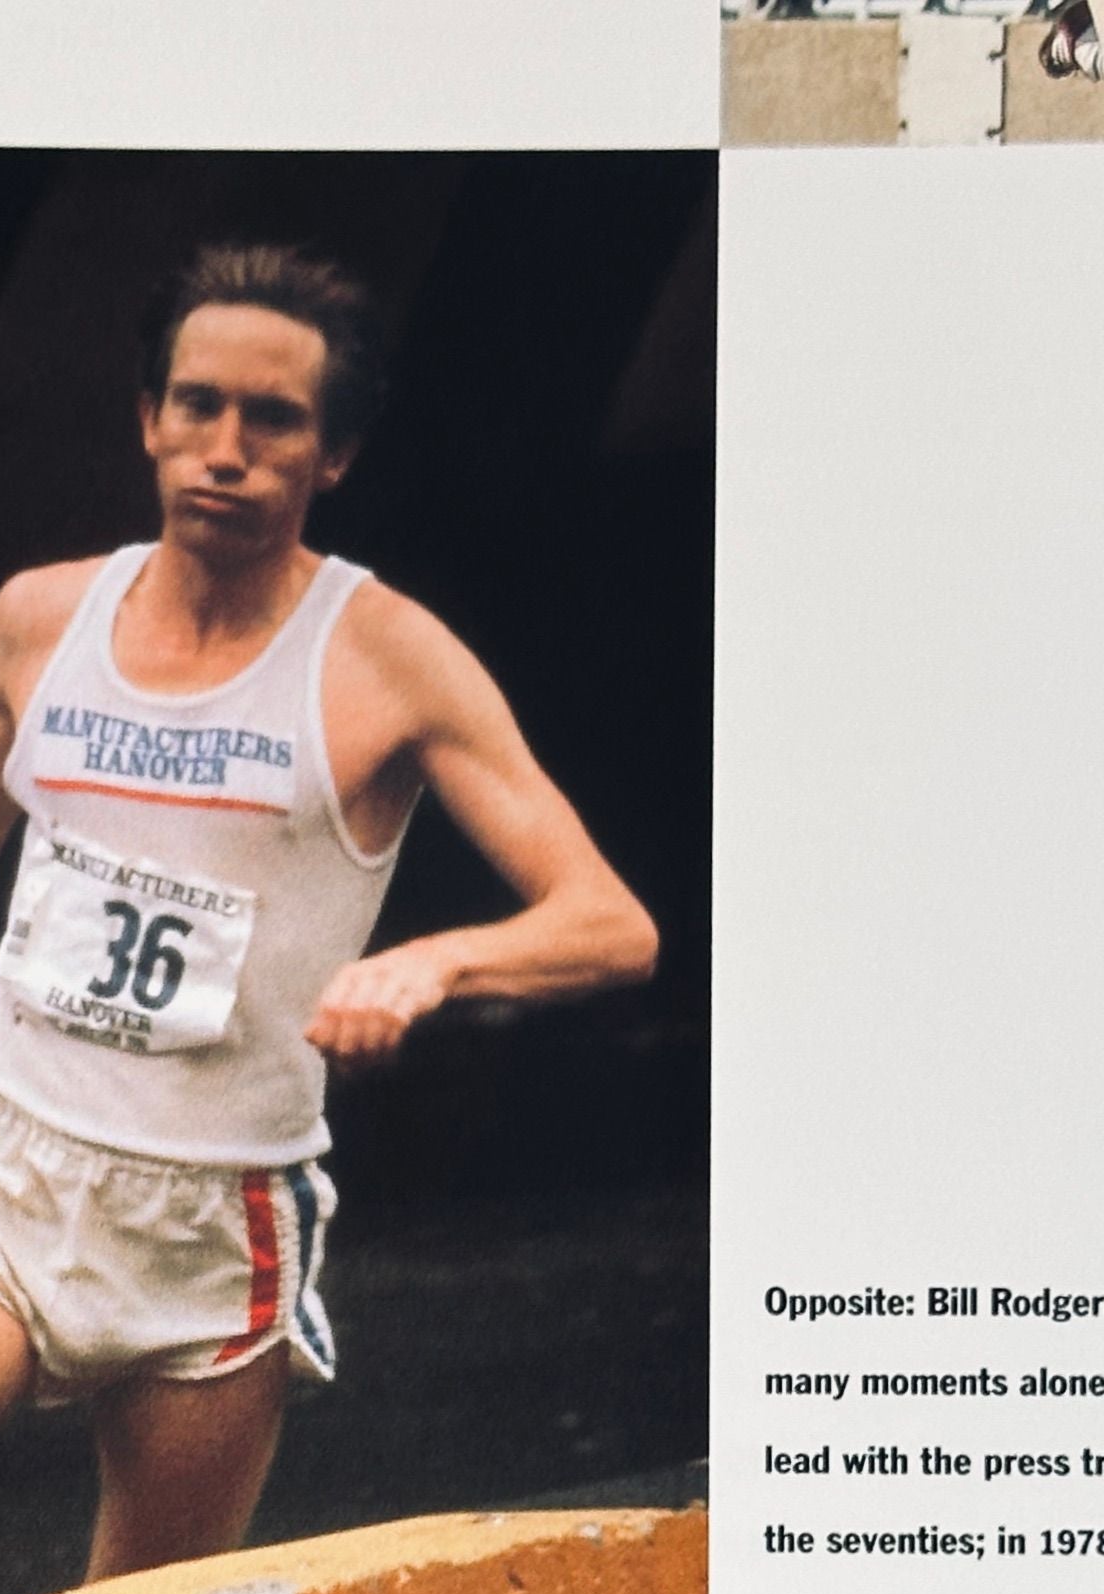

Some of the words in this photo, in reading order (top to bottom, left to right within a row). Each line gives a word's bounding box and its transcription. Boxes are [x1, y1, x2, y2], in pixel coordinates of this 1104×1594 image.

[41, 706, 293, 768] MANUFACTURERS
[84, 742, 226, 785] HANOVER
[51, 841, 241, 918] MANUACTURERS
[87, 899, 193, 1011] 36
[46, 986, 151, 1034] HANOVER
[764, 1286, 915, 1322] Opposite:
[927, 1286, 978, 1316] Bill
[765, 1373, 850, 1401] many
[861, 1367, 1009, 1397] moments
[1019, 1367, 1104, 1397] alone
[765, 1445, 830, 1475] lead
[842, 1445, 908, 1475] with
[920, 1446, 972, 1476] the
[984, 1454, 1071, 1482] press
[764, 1524, 815, 1554] the
[826, 1525, 985, 1560] seventies;
[998, 1526, 1026, 1555] in
